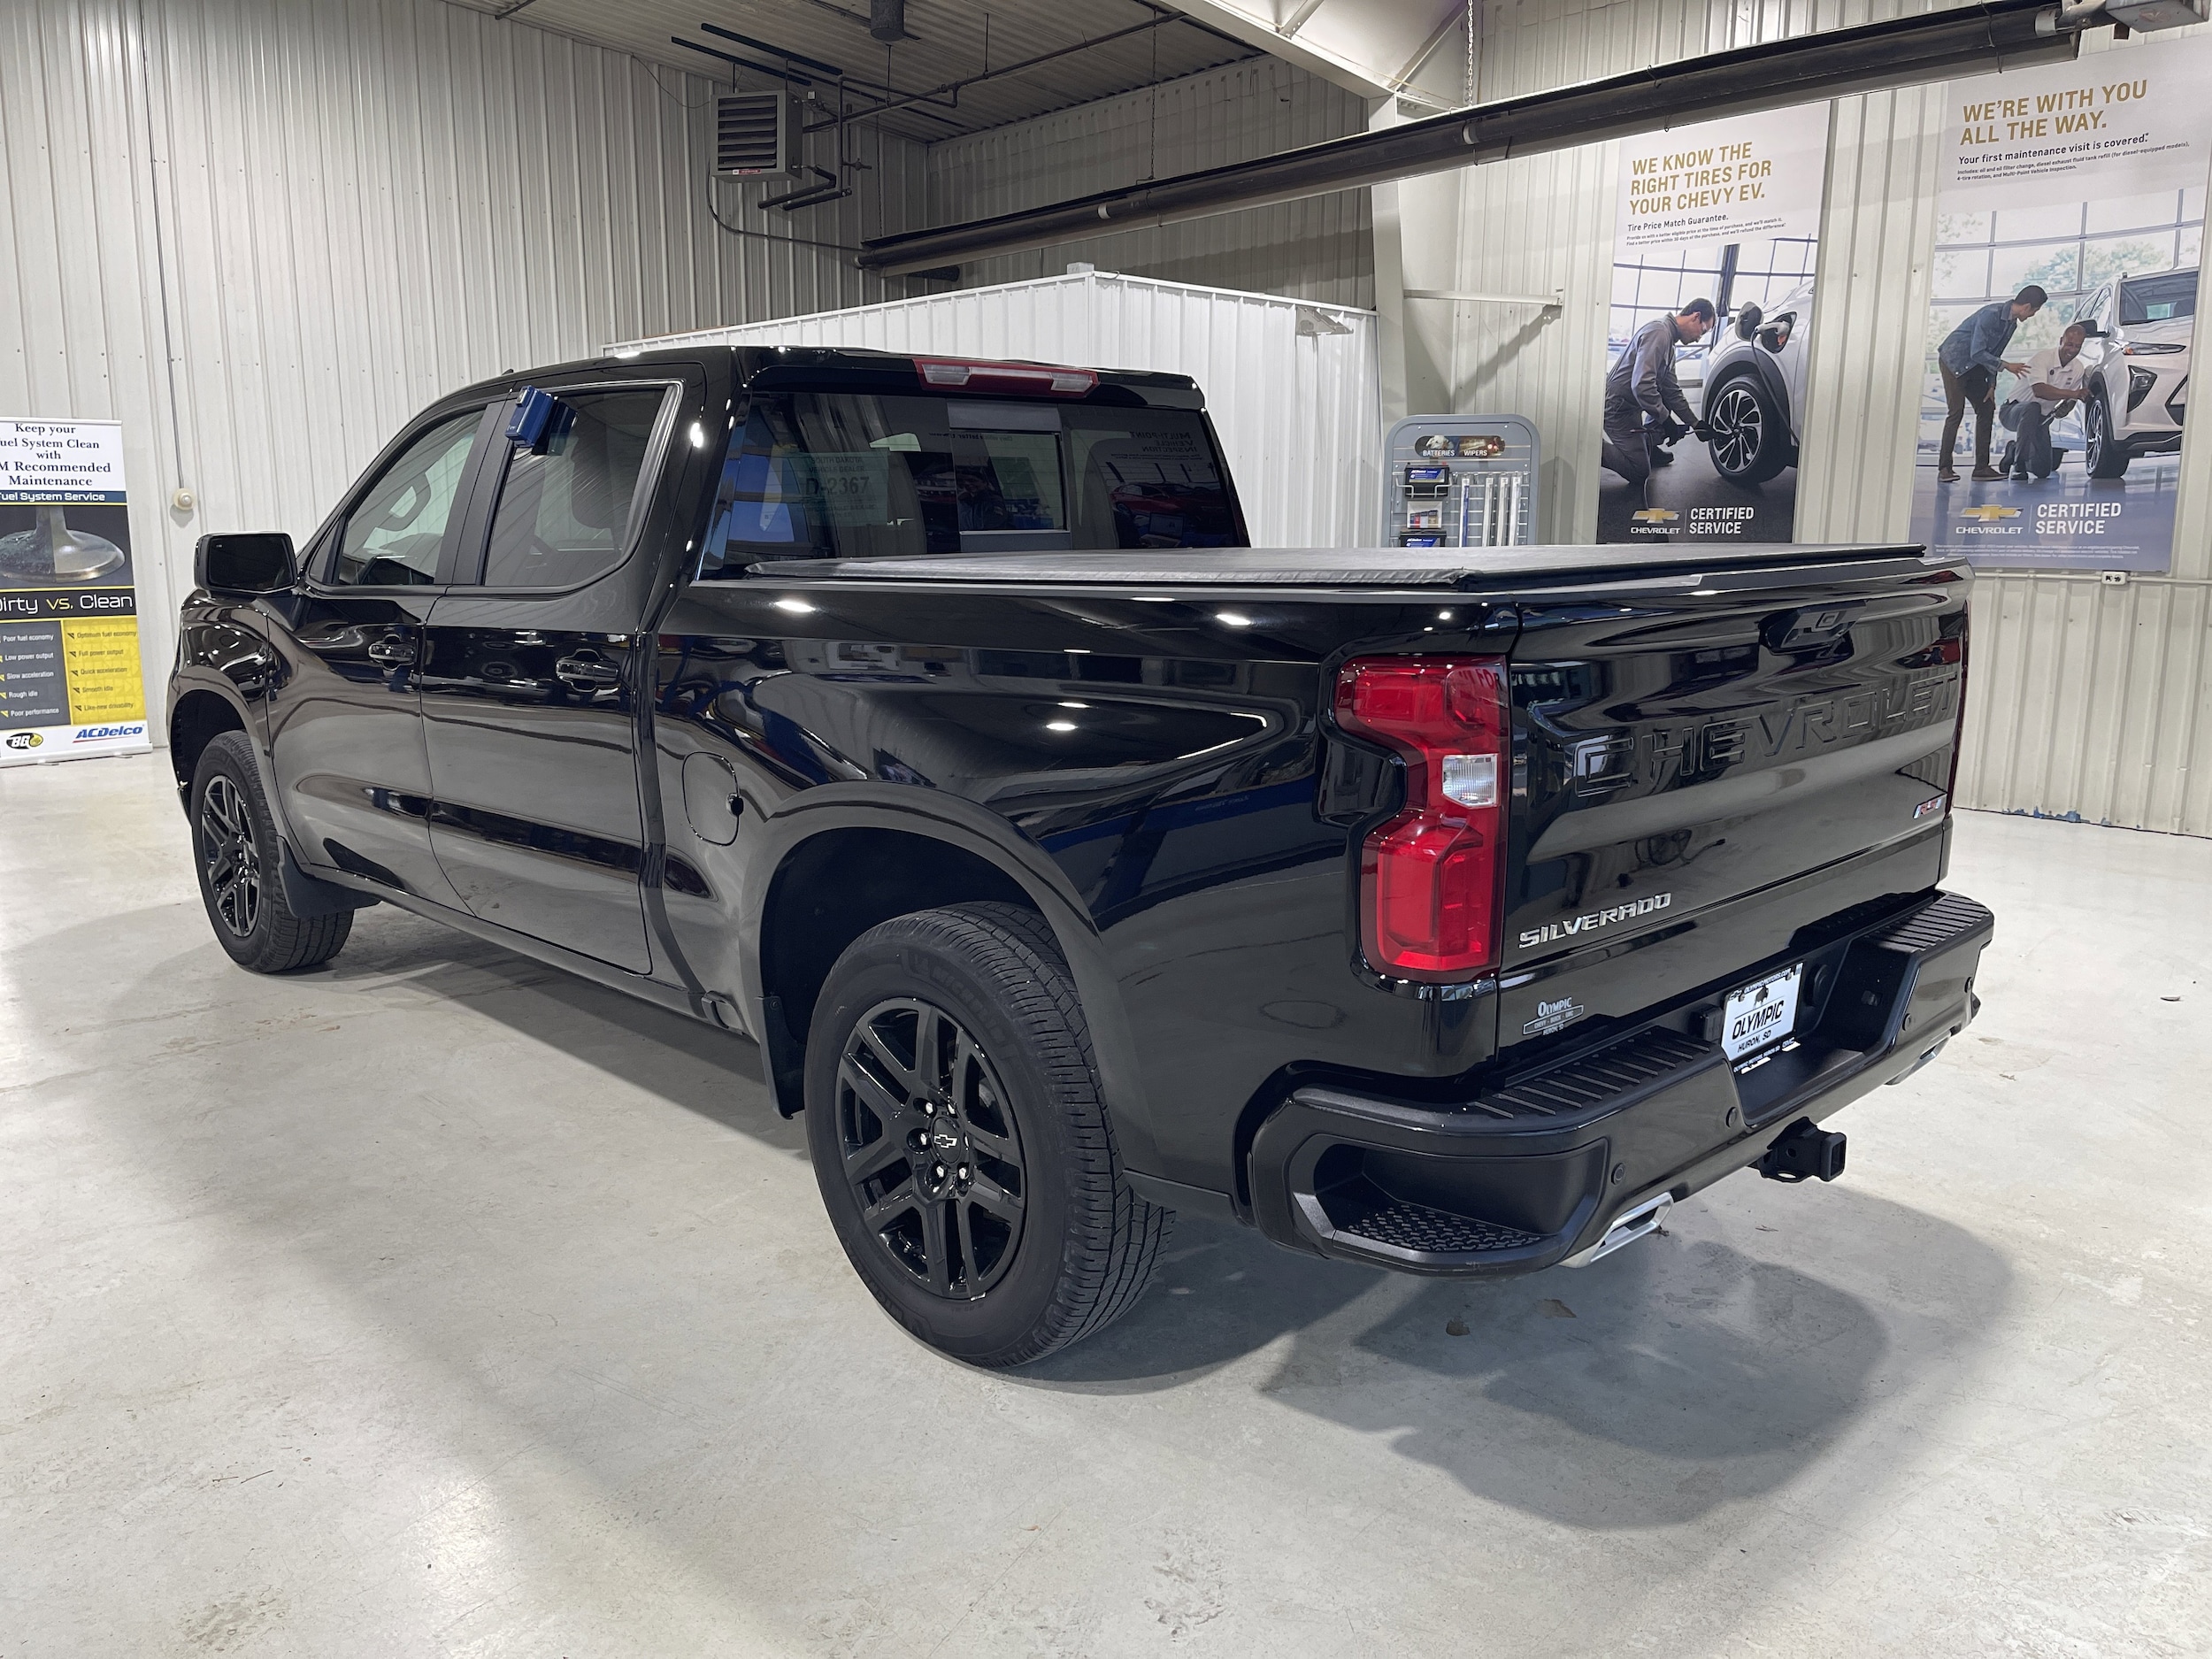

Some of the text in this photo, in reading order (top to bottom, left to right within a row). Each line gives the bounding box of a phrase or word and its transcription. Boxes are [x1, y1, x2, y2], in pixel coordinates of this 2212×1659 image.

[1962, 80, 2147, 122] WE'RE WITH YOU
[1960, 110, 2108, 146] ALL THE WAY.
[1632, 142, 1753, 175] WE KNOW THE
[1958, 156, 1979, 165] Your
[1982, 153, 2002, 163] first
[2005, 146, 2067, 160] maintenance
[2069, 142, 2090, 153] visit
[2093, 140, 2101, 150] is
[1631, 159, 1772, 196] RIGHT TIRES FOR
[1630, 182, 1765, 216] YOUR CHEVY EV.
[1643, 221, 1662, 230] Price
[1663, 218, 1686, 228] Match
[1687, 214, 1729, 225] Guarantee.
[15, 423, 76, 436] Keep your
[0, 438, 100, 450] uel System Clean
[36, 449, 62, 459] with
[0, 461, 111, 472] M Recommended
[9, 475, 93, 487] Maintenance
[805, 476, 870, 495] D-2367
[19, 492, 63, 503] System
[65, 493, 105, 502] Service
[1690, 507, 1755, 520] CERTIFIED
[2037, 503, 2122, 518] CERTIFIED
[1689, 521, 1742, 534] SERVICE
[1955, 526, 2024, 534] CHEVROLET
[2035, 519, 2106, 534] SERVICE
[46, 597, 73, 611] vs.
[80, 595, 134, 609] Clean
[75, 726, 143, 740] ACDelco
[1574, 671, 1958, 797] CHEVROLET
[12, 735, 31, 748] BG
[1519, 893, 1671, 949] SILVERADO
[1538, 996, 1572, 1018] OLYMPIC
[1732, 1000, 1785, 1041] OLYMPIC
[1762, 1030, 1771, 1041] SD
